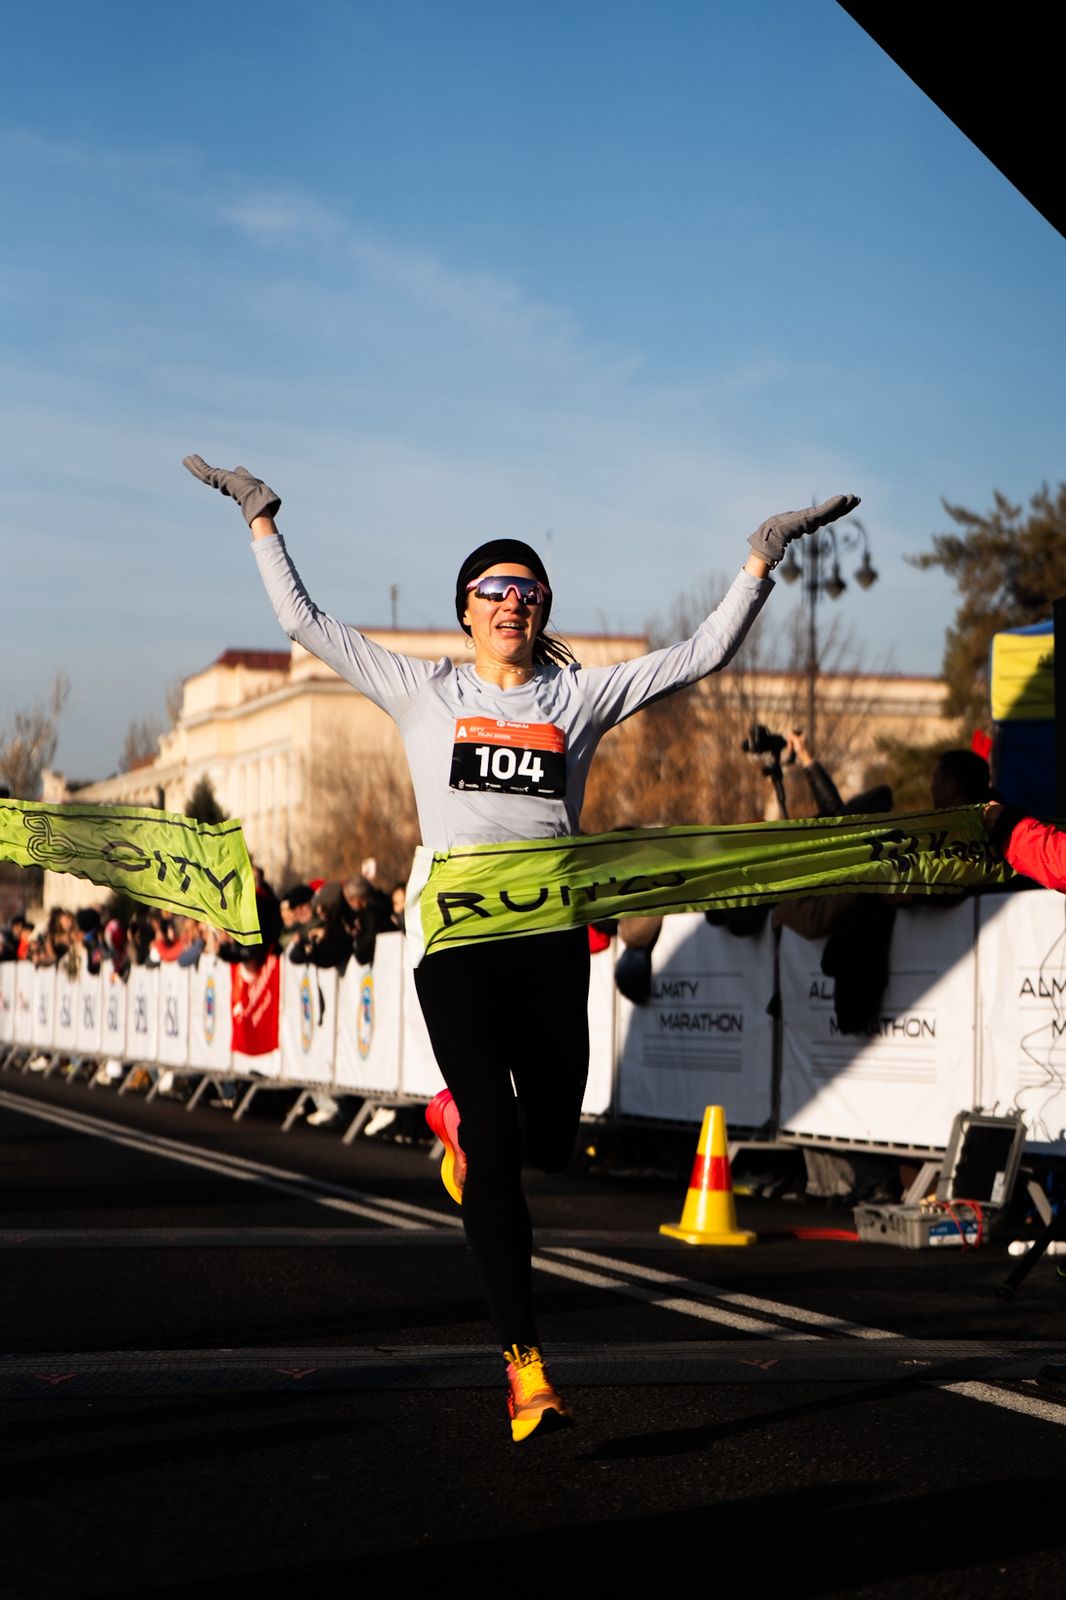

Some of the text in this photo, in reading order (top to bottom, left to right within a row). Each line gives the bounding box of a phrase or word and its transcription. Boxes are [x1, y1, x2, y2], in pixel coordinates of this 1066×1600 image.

[457, 726, 468, 739] A
[475, 746, 544, 783] 104
[101, 841, 237, 910] CITY
[651, 981, 699, 999] LMATY
[660, 1012, 743, 1033] MARATHON
